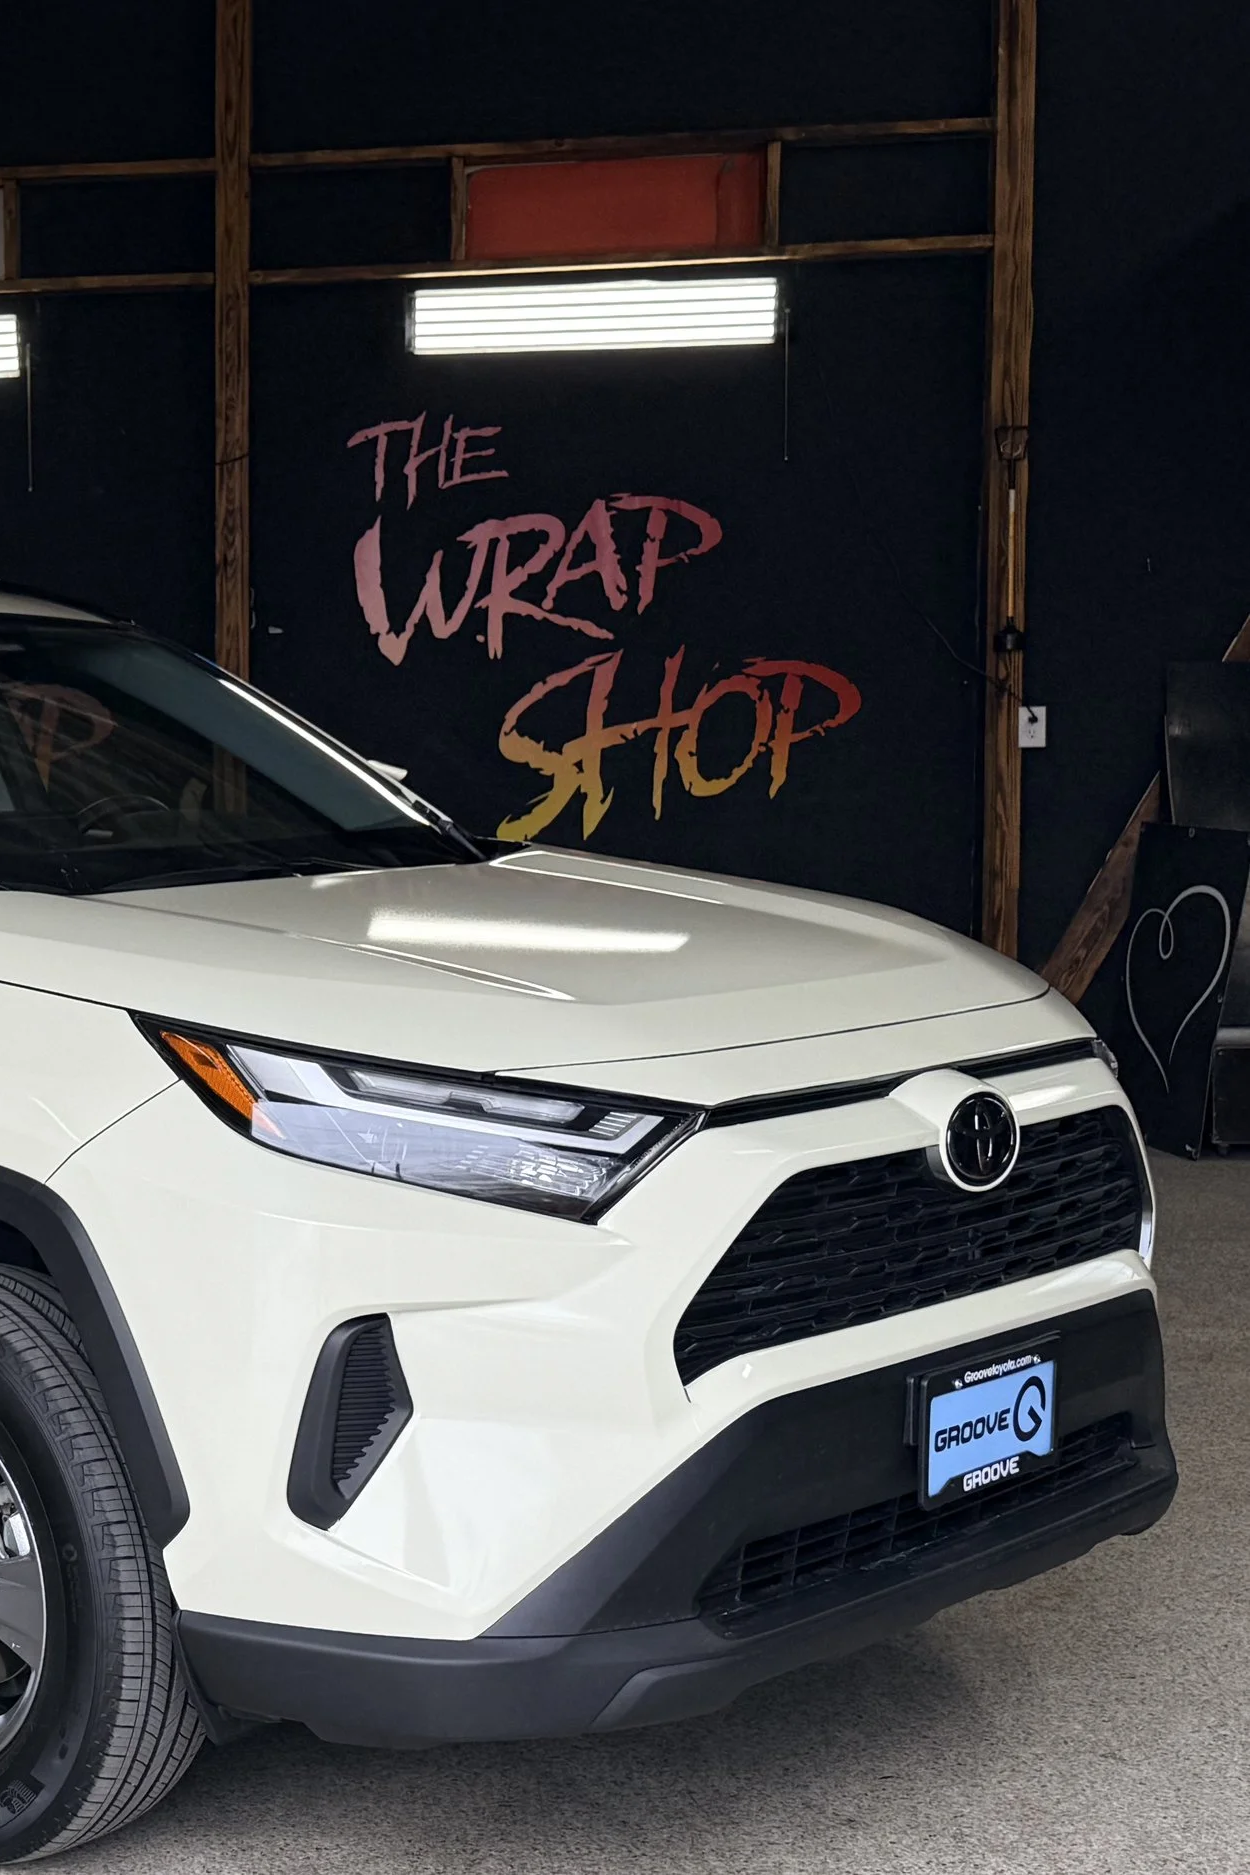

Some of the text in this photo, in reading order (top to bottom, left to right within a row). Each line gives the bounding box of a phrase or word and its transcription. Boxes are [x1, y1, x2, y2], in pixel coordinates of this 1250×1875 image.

[348, 411, 509, 510] THE
[354, 493, 722, 666] WRAP
[497, 645, 861, 841] SHOP
[934, 1408, 1011, 1453] GROOVE
[963, 1456, 1020, 1492] GROOVE
